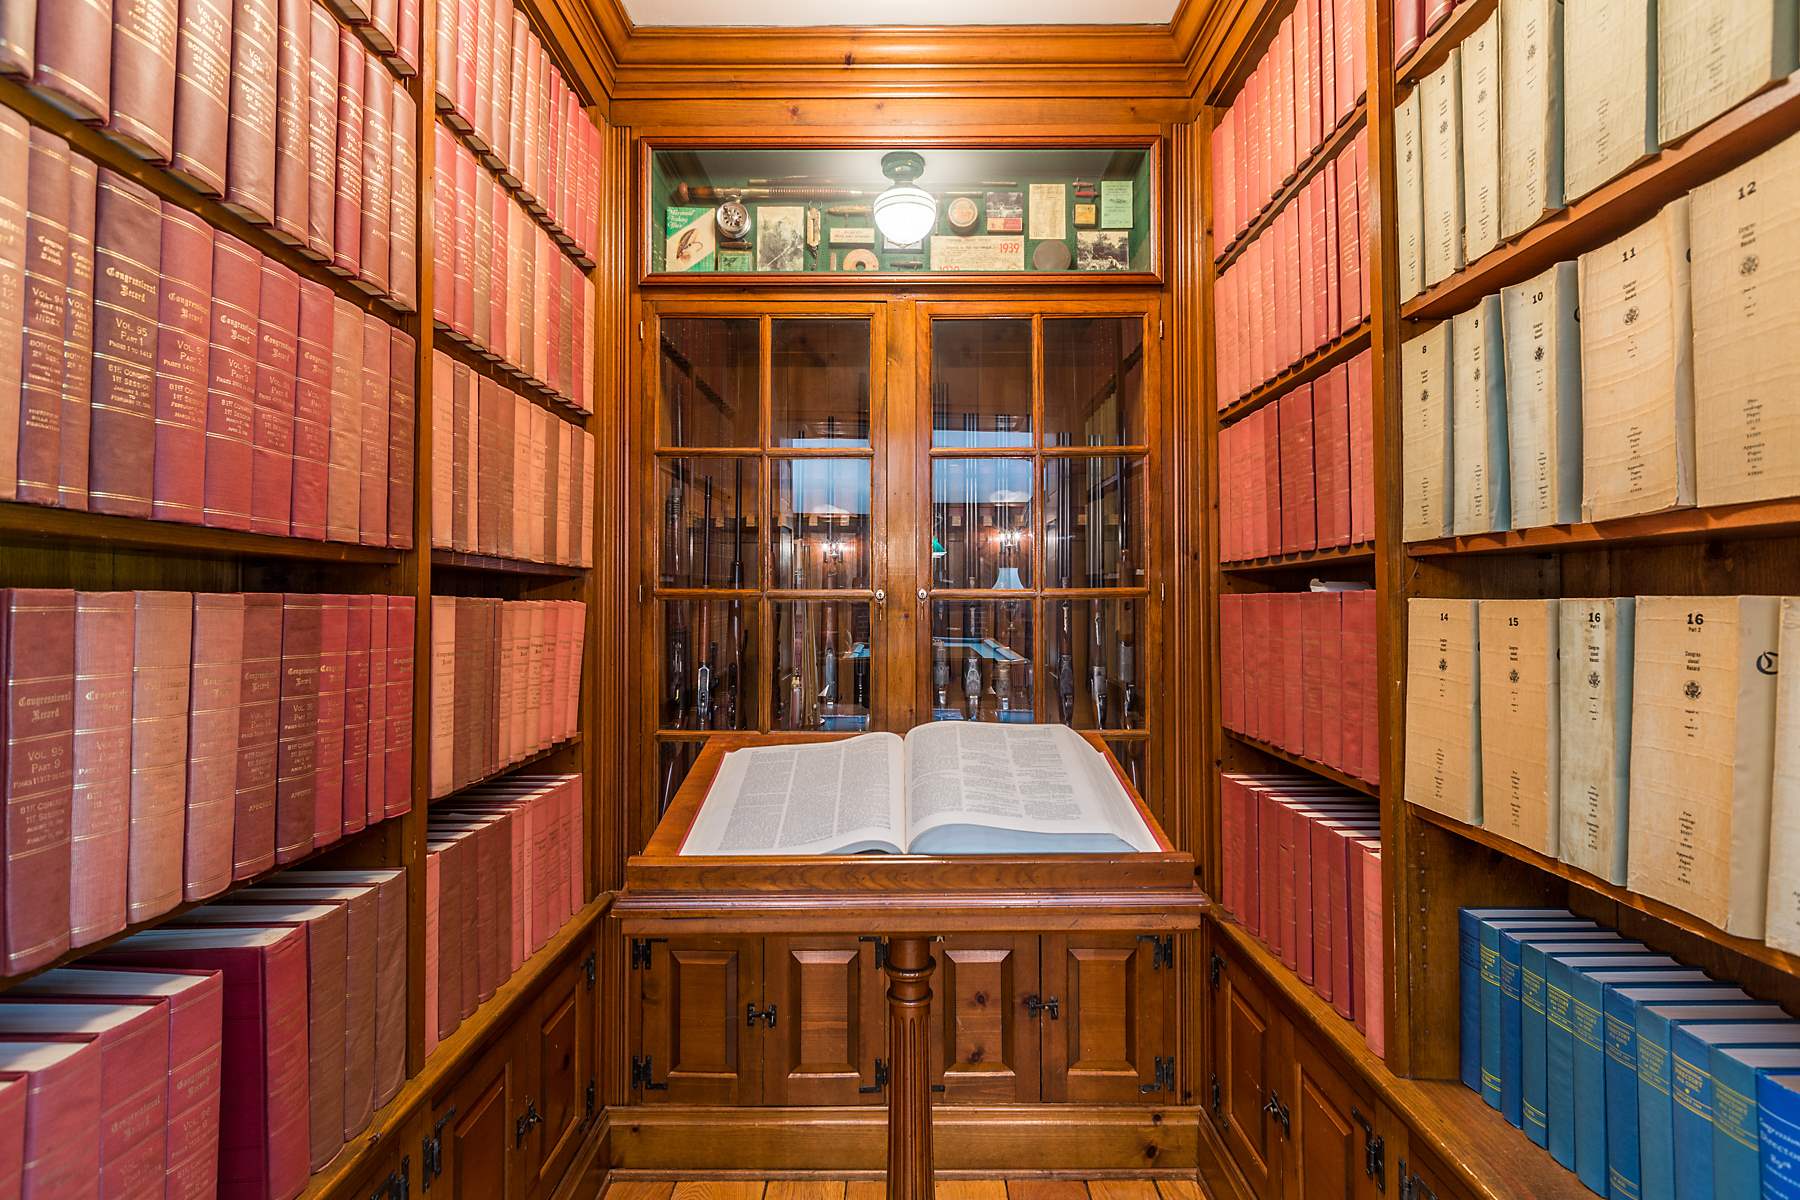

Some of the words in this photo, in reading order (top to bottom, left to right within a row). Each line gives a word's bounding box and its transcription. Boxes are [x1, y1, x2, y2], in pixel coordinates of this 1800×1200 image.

[1738, 181, 1757, 200] 12
[999, 242, 1020, 254] 1939
[1622, 247, 1636, 262] 11
[106, 266, 156, 295] Congressional
[120, 284, 146, 304] Record
[1532, 292, 1544, 304] 10
[1474, 320, 1479, 328] 9
[137, 326, 148, 337] 95
[1440, 613, 1448, 621] 14
[1508, 617, 1519, 626] 15
[1588, 612, 1600, 622] 16
[1687, 613, 1704, 625] 16
[18, 691, 72, 708] Congressional
[32, 708, 60, 723] Record
